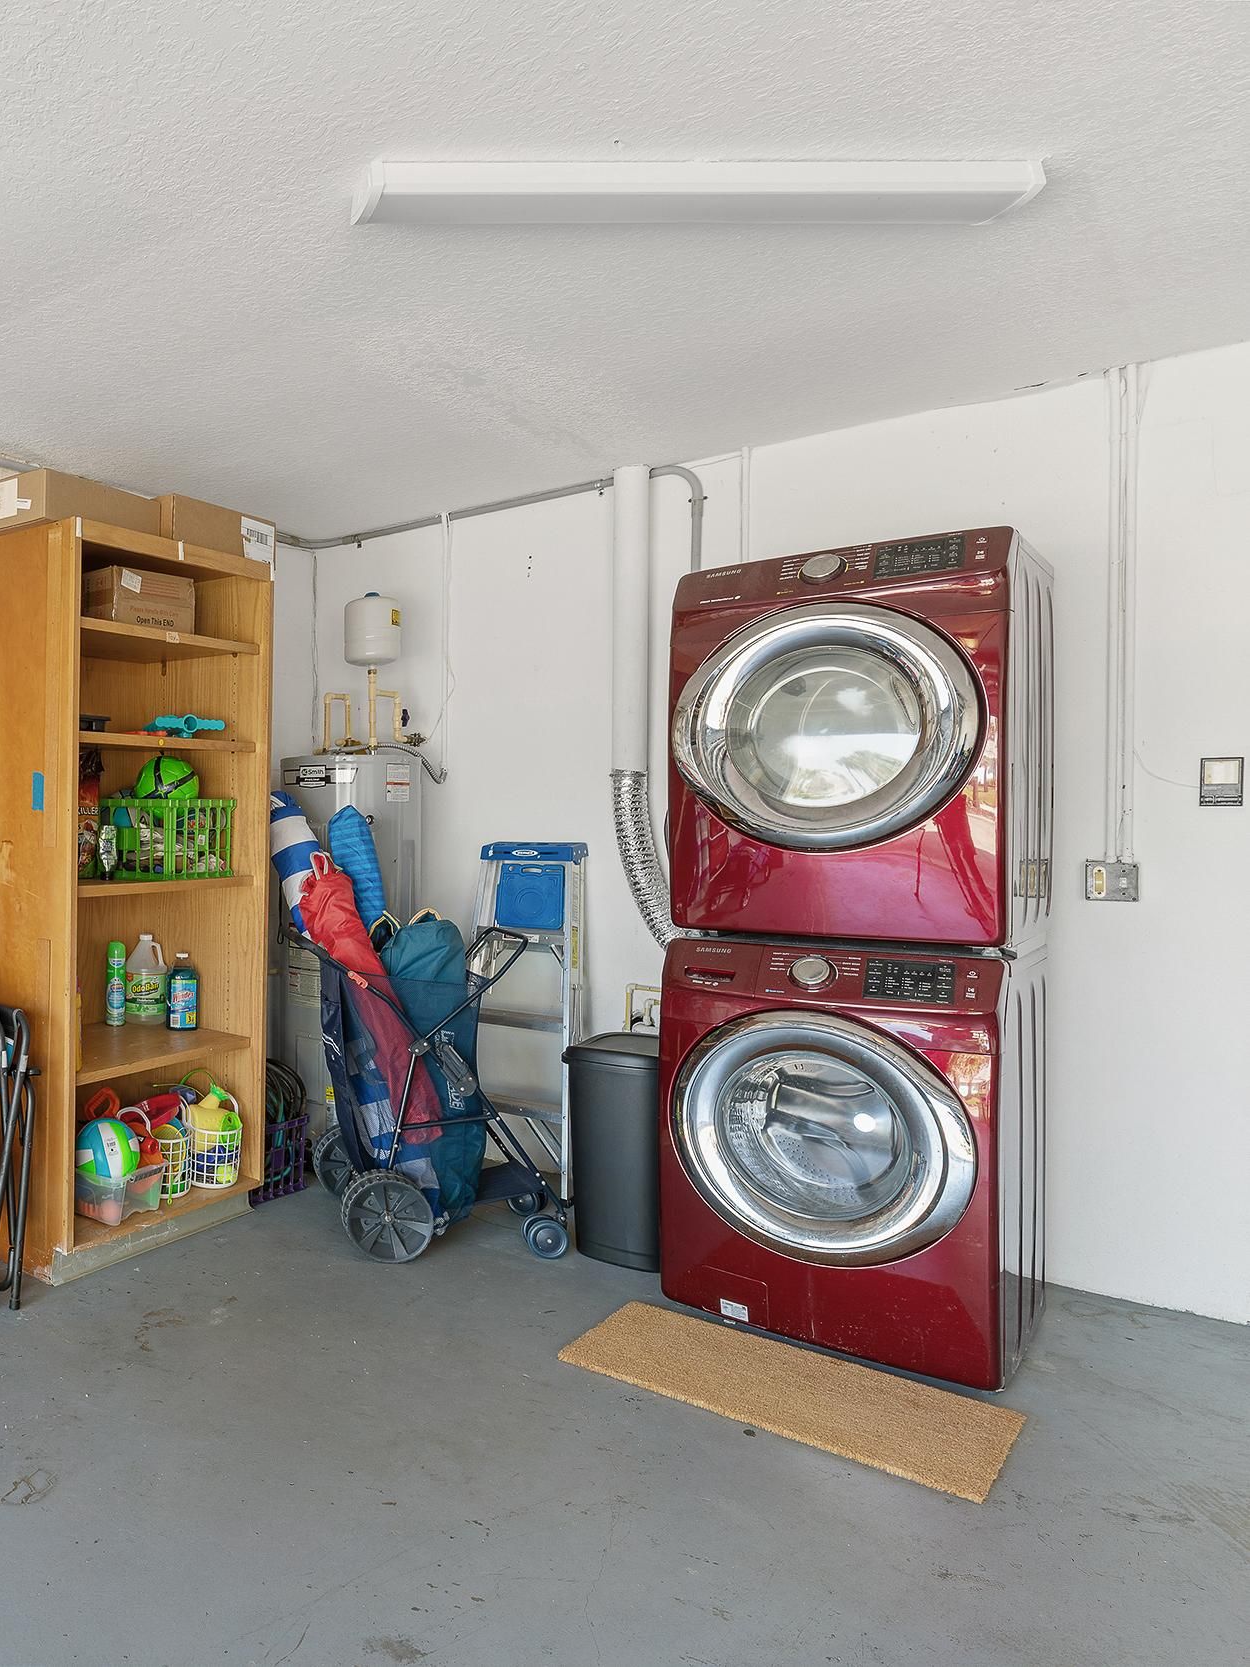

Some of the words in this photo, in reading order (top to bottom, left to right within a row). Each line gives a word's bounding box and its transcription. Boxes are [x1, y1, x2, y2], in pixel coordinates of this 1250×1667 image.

[706, 569, 742, 579] SAMSUNG
[136, 615, 150, 625] Open
[151, 617, 162, 626] This
[162, 619, 175, 627] END
[695, 946, 732, 954] SAMSUNG
[132, 982, 159, 993] OdoBan
